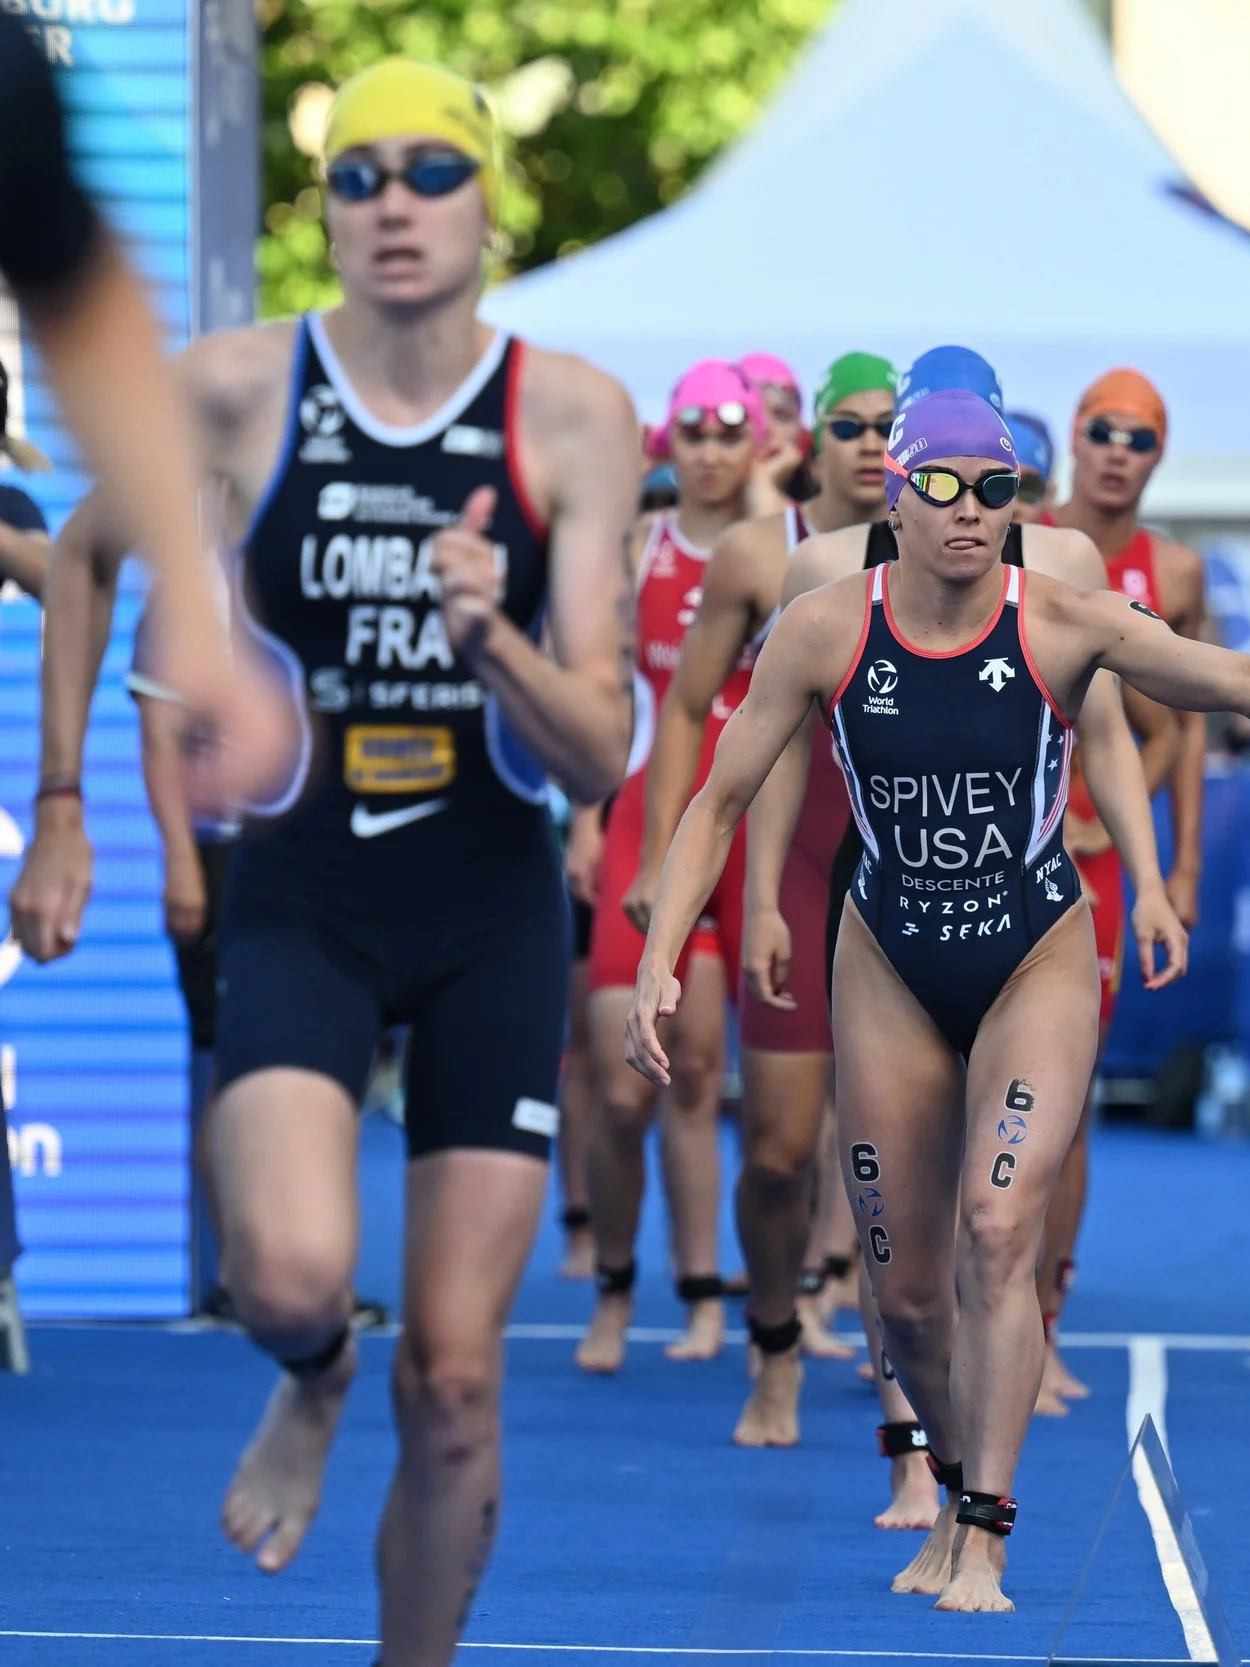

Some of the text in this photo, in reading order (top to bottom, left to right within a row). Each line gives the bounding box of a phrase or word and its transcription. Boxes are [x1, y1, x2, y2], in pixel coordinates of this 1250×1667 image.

[888, 412, 906, 452] C
[896, 437, 928, 467] EROD
[345, 604, 454, 670] FRA
[862, 704, 899, 716] Triathlon
[868, 695, 894, 706] World
[869, 767, 1022, 817] SPIVEY
[894, 822, 1014, 870] USA
[901, 870, 1005, 892] DESCENTE
[1035, 852, 1062, 884] NYAC
[939, 913, 1012, 942] SEKA
[1004, 1078, 1035, 1113] 6
[850, 1141, 881, 1183] 6
[990, 1151, 1017, 1190] C
[868, 1224, 893, 1266] C
